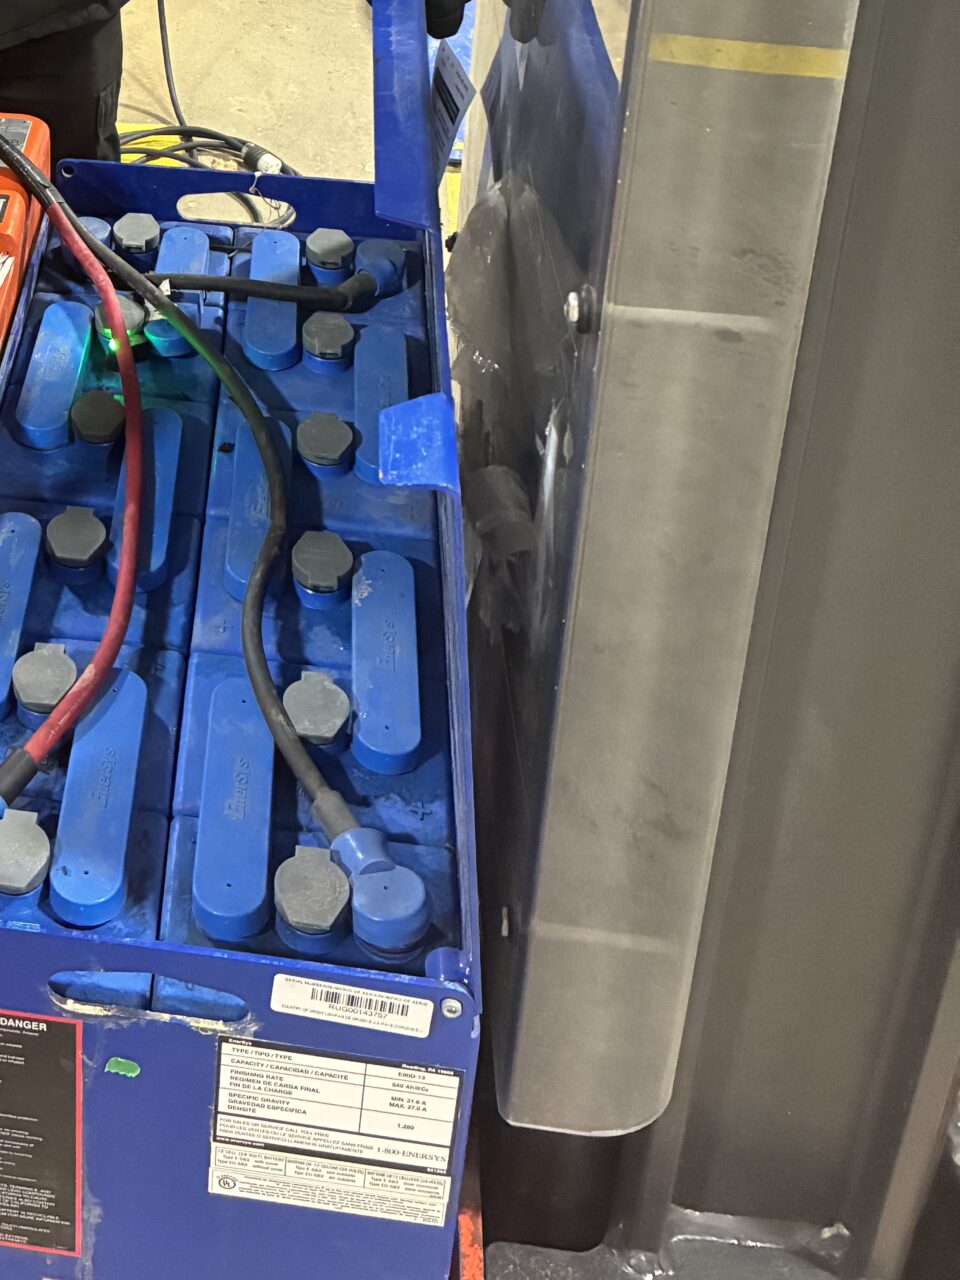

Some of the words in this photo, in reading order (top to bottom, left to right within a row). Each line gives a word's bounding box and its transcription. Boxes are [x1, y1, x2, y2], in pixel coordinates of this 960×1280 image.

[0, 1017, 47, 1031] DANGER
[232, 1047, 250, 1055] TYPE
[230, 1058, 265, 1068] CAPACITY
[300, 1084, 321, 1093] FINAL
